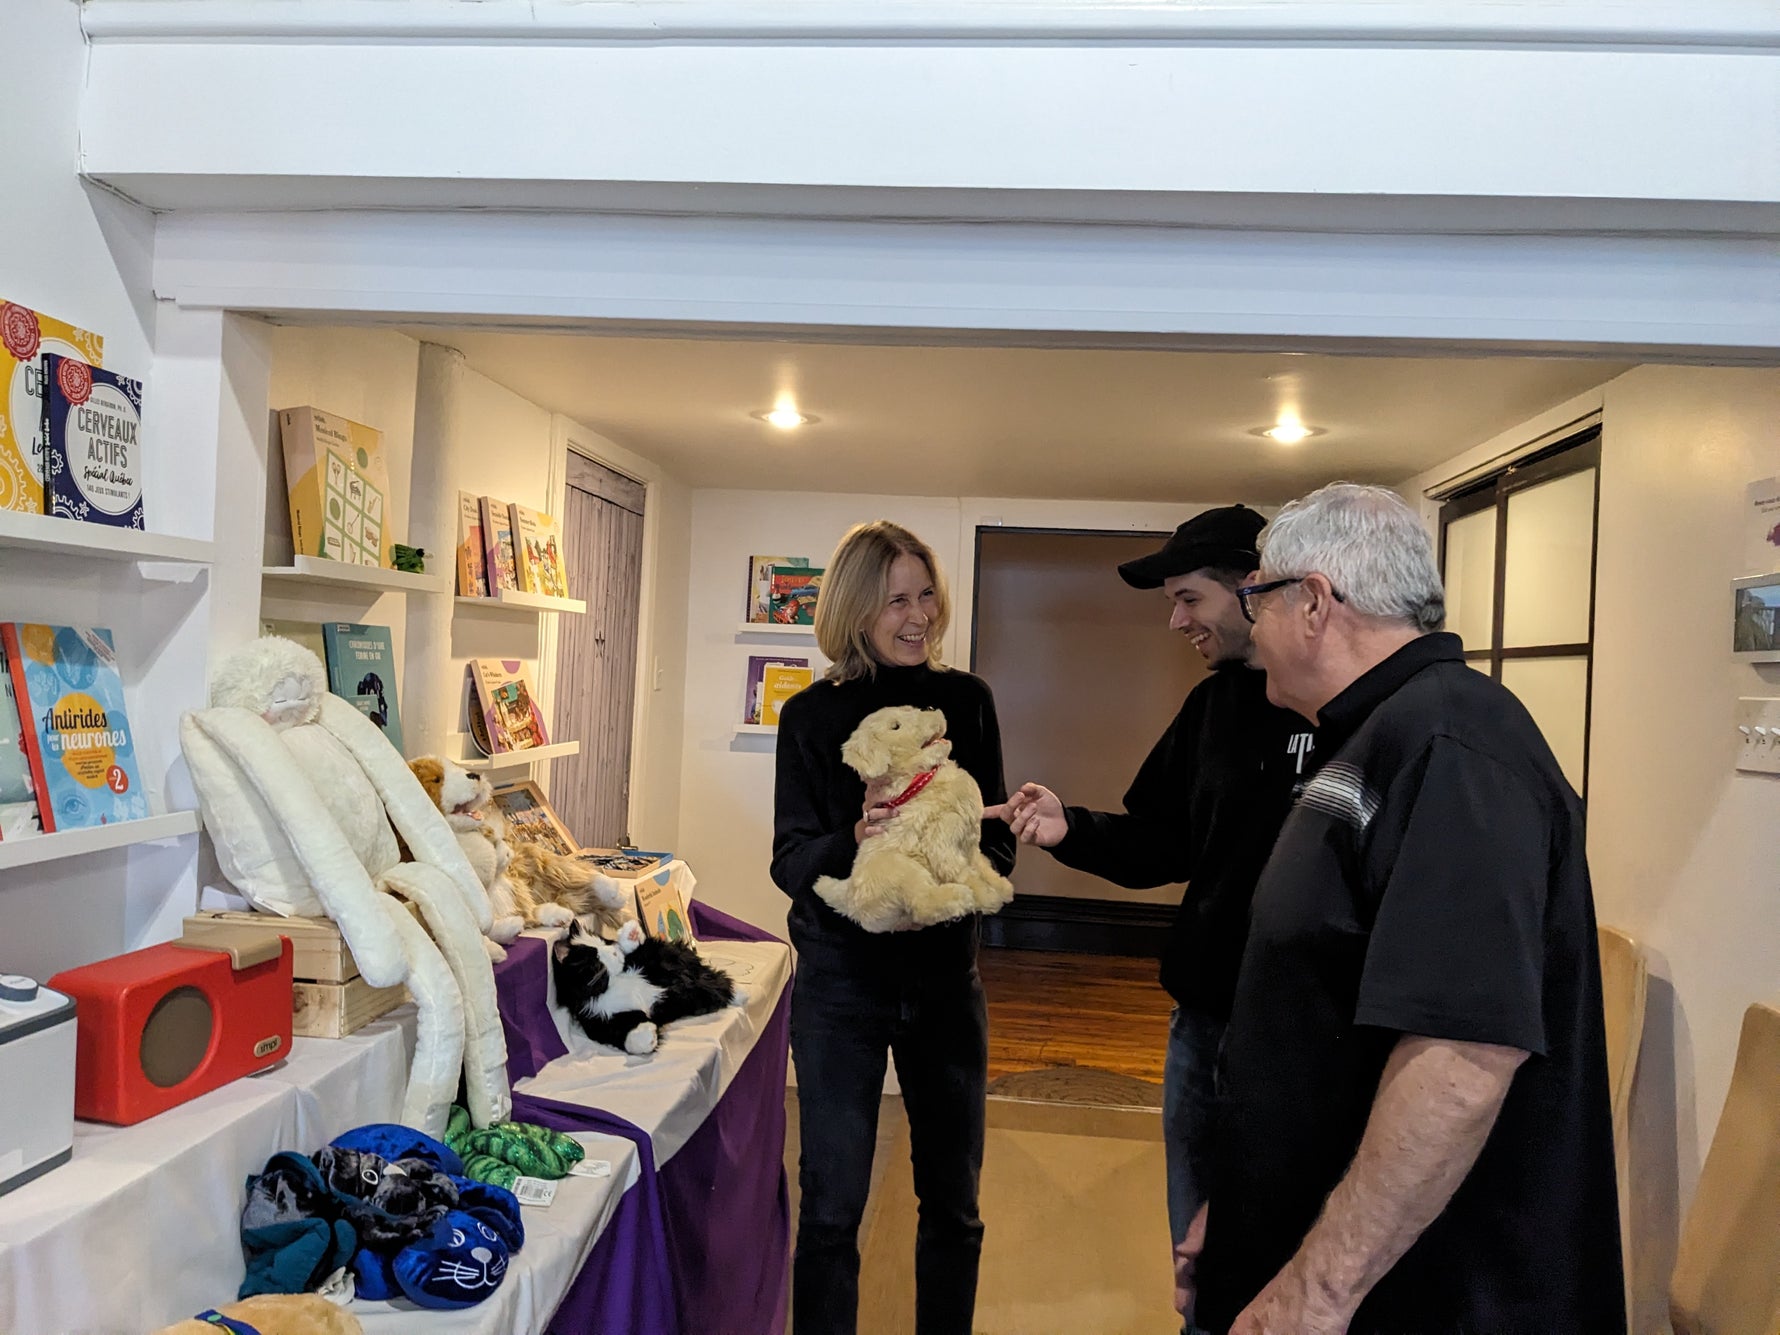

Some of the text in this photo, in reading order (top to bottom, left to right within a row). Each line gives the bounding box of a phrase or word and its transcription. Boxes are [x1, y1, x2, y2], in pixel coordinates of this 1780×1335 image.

[78, 407, 137, 446] CERVEAUX
[88, 436, 128, 469] ACTIFS
[84, 465, 133, 486] Spécial Québec
[42, 708, 107, 733] Antirides
[61, 728, 126, 750] neurones
[113, 768, 124, 790] 2
